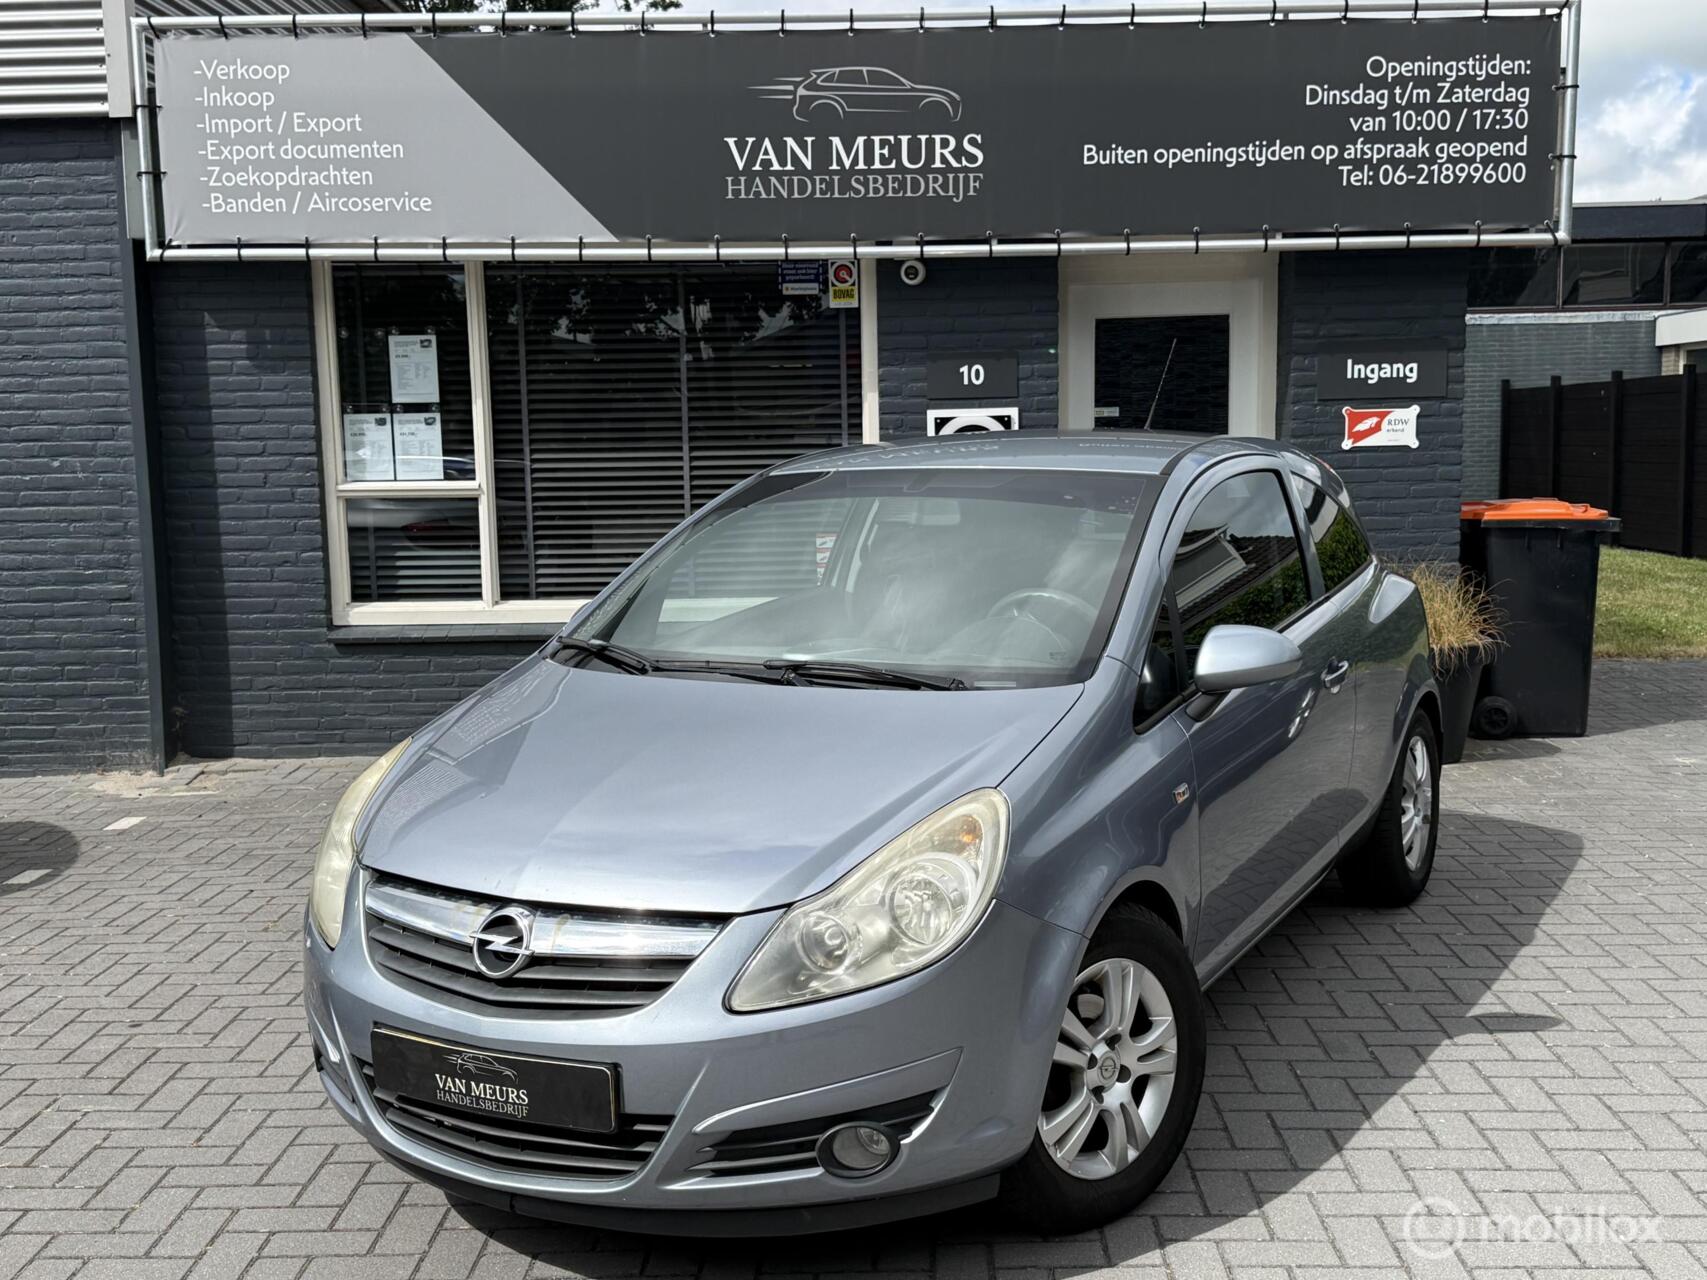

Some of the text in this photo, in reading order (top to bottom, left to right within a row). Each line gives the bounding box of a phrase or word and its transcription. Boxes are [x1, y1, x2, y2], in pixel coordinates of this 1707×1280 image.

[193, 58, 290, 84] -Verkoop
[1366, 53, 1531, 82] Openingstijden:
[195, 85, 275, 111] -Inkoop
[1305, 81, 1530, 110] Dinsdag t/m Zaterdag
[196, 111, 362, 138] -Import / Export
[1350, 108, 1529, 132] van 10:00 / 17:30
[198, 138, 404, 165] -Export documenten
[723, 133, 984, 171] VAN MEURS
[1083, 135, 1527, 168] Buiten openingstijden op afspraak geopend
[200, 165, 373, 191] -Zoekopdrachten
[1338, 162, 1527, 186] Tel: 06-21899600
[725, 173, 984, 202] HANDELSBEDRIJF
[202, 191, 432, 214] -Banden / Aircoservice
[833, 288, 855, 299] BOVAG
[959, 364, 985, 385] 10
[1346, 358, 1418, 384] Ingang
[1387, 418, 1410, 426] RDW
[435, 1073, 528, 1105] VAN MEURS
[436, 1089, 529, 1118] HANDELSBEDRIJF
